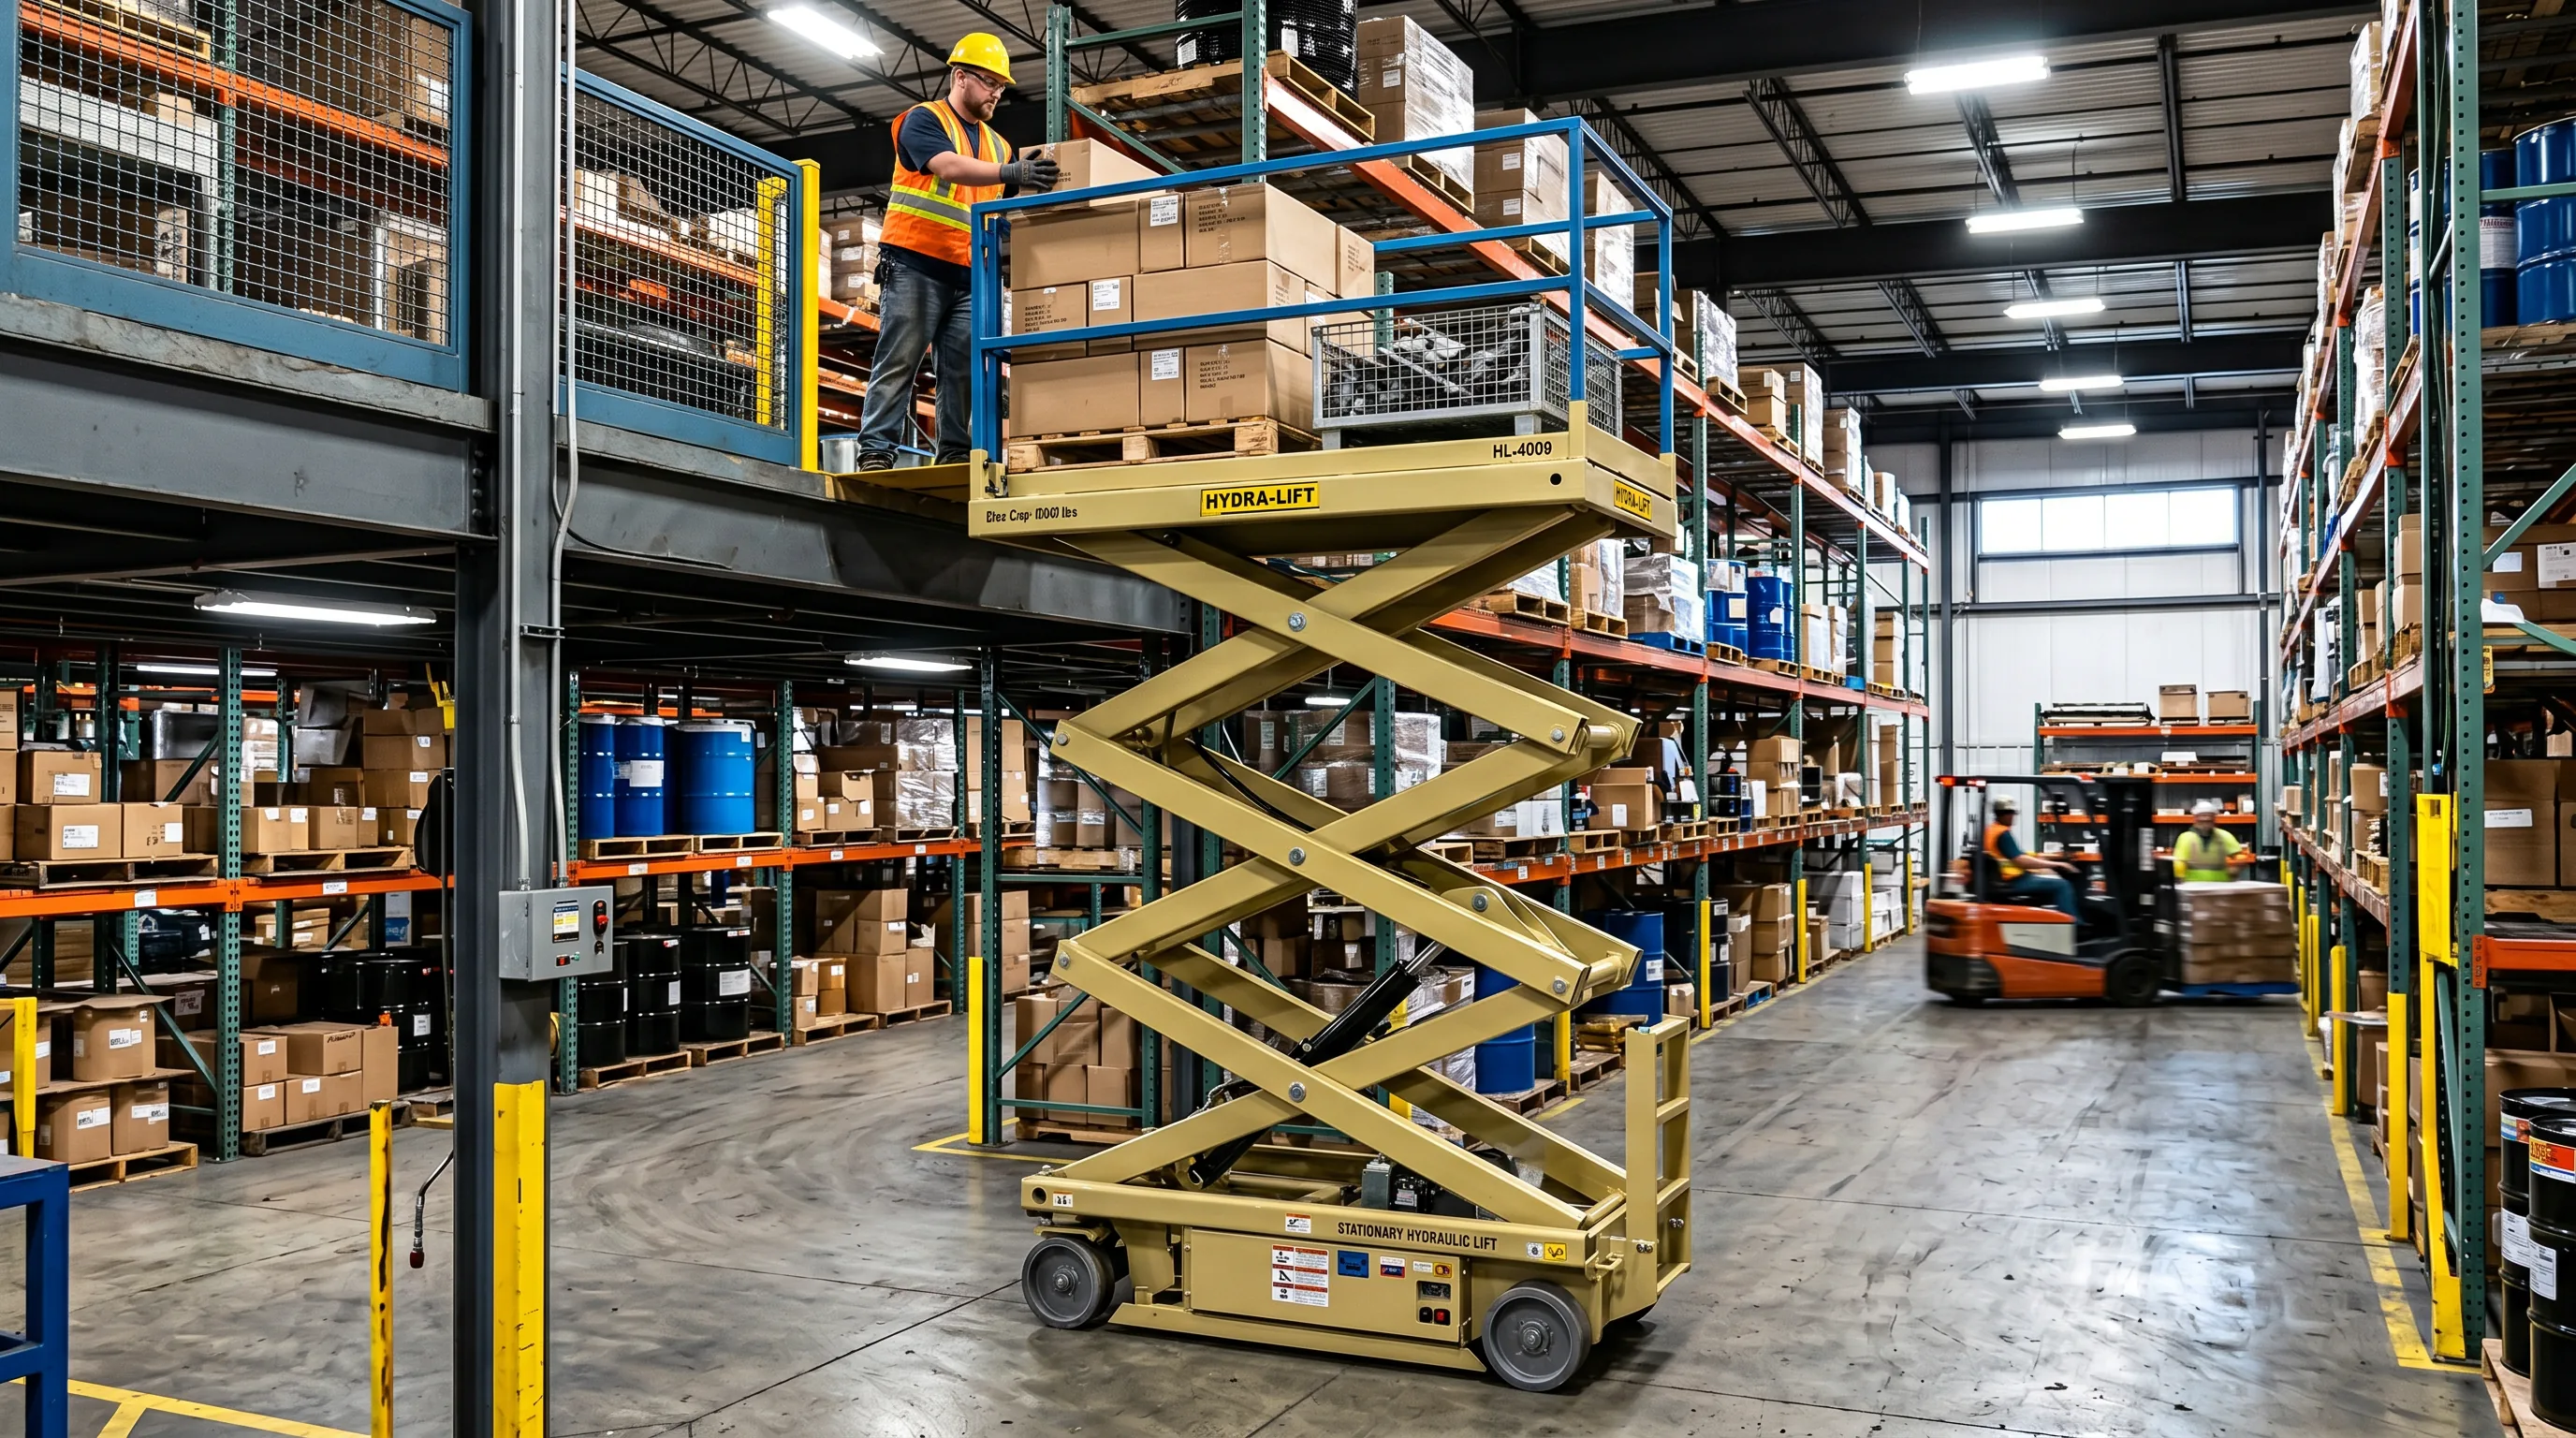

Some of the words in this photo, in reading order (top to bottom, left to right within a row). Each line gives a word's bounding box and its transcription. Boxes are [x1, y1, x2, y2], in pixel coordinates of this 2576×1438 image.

[1493, 441, 1552, 458] HL-4009
[1206, 487, 1315, 509] HYDRA-LIFT
[1338, 1222, 1403, 1240] STATIONARY
[1407, 1228, 1471, 1248] HYDRAULIC
[1473, 1235, 1498, 1251] LIFT
